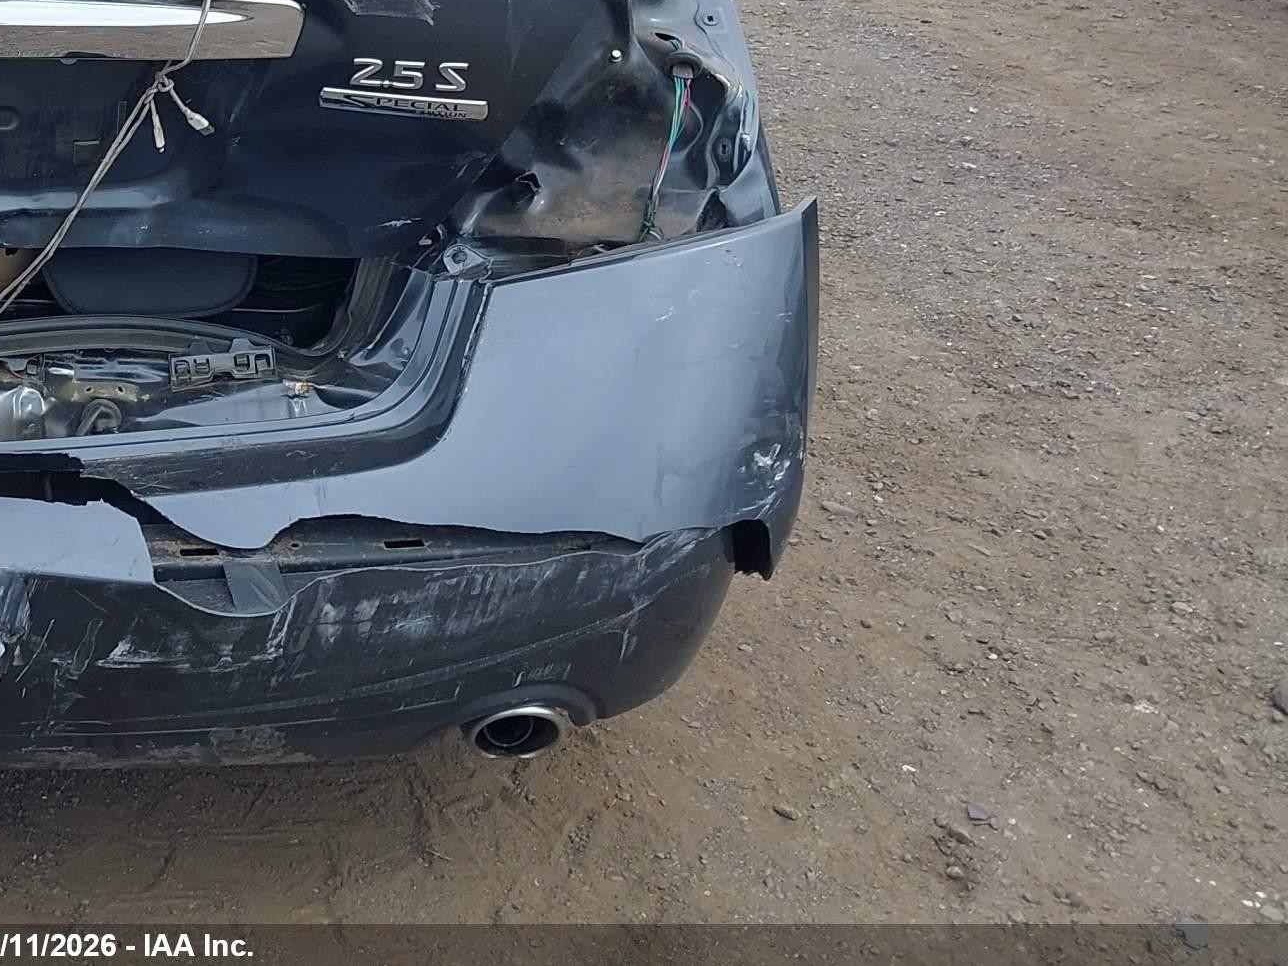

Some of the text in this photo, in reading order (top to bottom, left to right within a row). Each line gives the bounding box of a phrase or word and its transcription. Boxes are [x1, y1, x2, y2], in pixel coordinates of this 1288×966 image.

[349, 57, 470, 92] 2.5 S
[340, 94, 468, 113] SPECIAL
